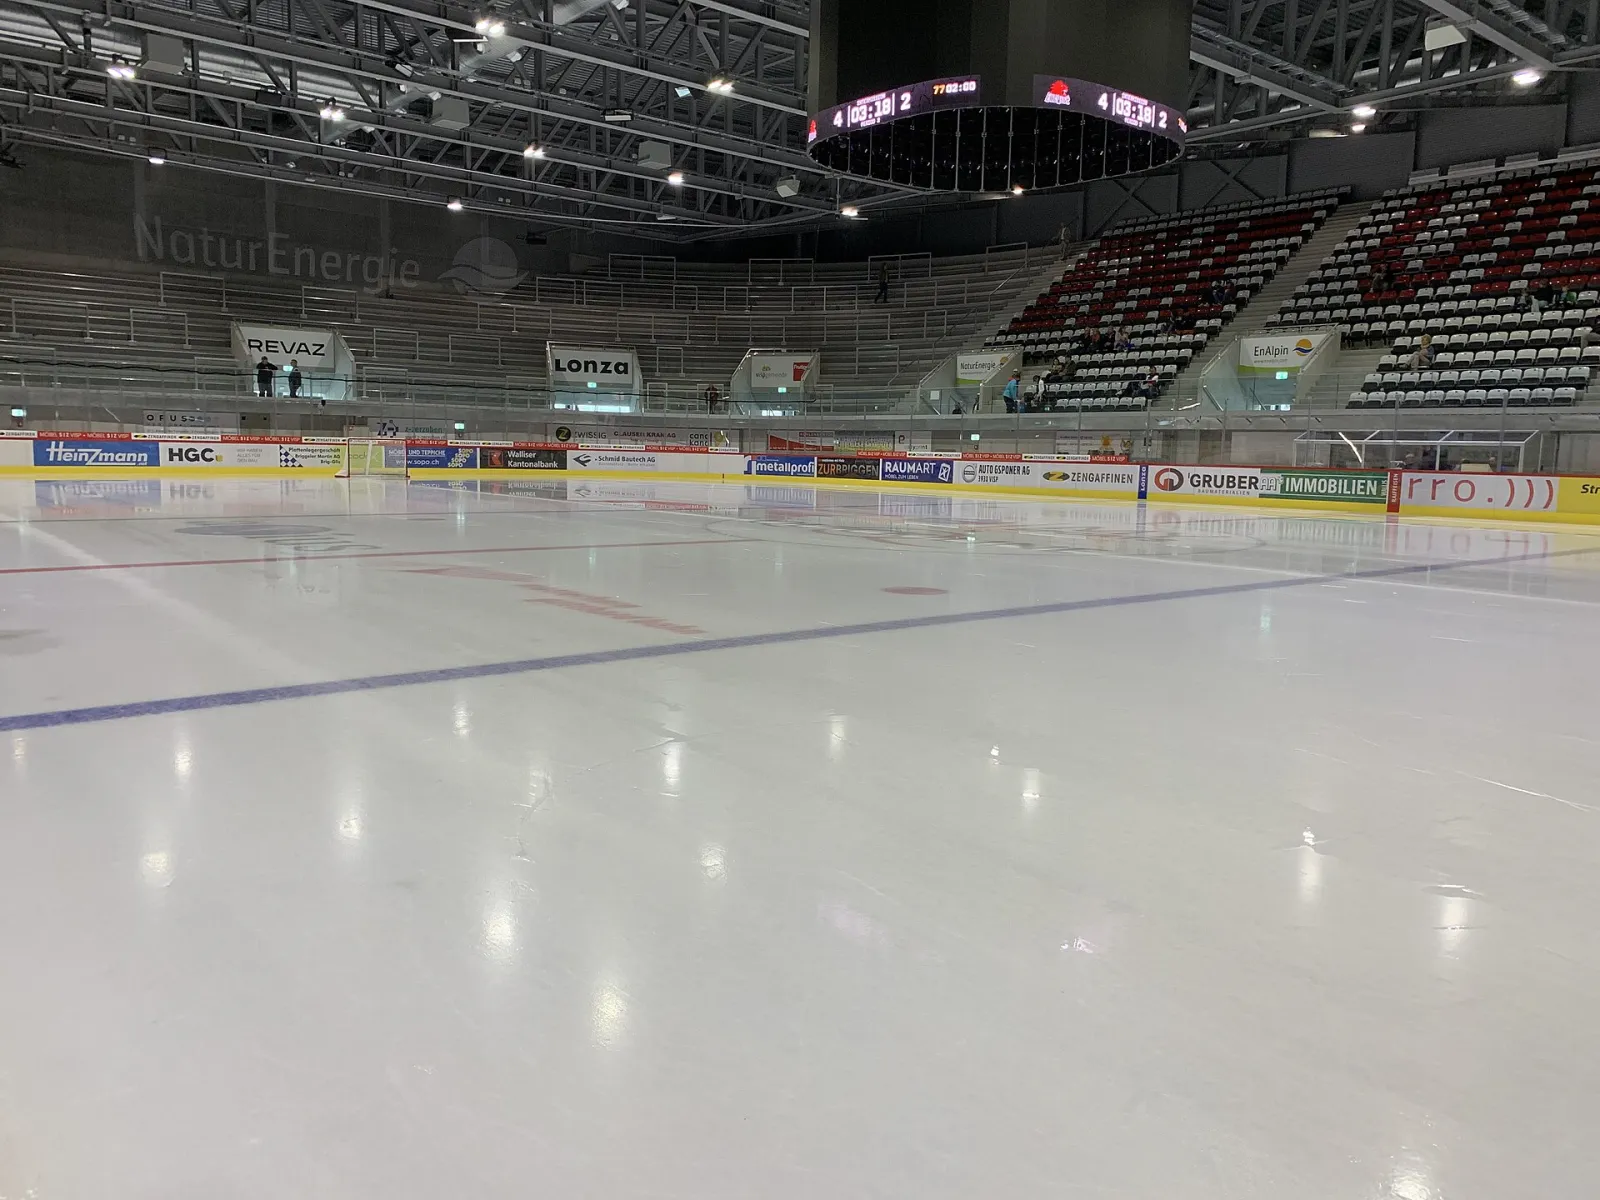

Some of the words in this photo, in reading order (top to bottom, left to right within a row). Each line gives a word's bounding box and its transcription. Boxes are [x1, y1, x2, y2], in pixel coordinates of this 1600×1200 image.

[833, 110, 843, 128] 4
[851, 98, 892, 124] 03:18
[900, 92, 911, 110] 2
[1098, 92, 1108, 110] 4
[1116, 97, 1152, 124] 03:18
[1158, 111, 1168, 128] 2
[133, 213, 420, 293] NaturEnergie
[247, 338, 326, 356] REVAZ
[1254, 345, 1288, 358] EnAlpin
[554, 358, 629, 375] Lonza
[960, 361, 996, 370] NaturEnergie
[508, 460, 558, 468] Kantonalbank
[756, 462, 815, 476] metallprofi
[818, 464, 878, 477] ZURBRIGGEN
[885, 462, 936, 474] RAUMART
[978, 464, 993, 474] AUTO
[994, 466, 1020, 475] GSPONER
[1022, 466, 1030, 475] AG
[1071, 472, 1133, 484] ZENGAFFINEN
[1286, 478, 1378, 496] IMMOBILIEN
